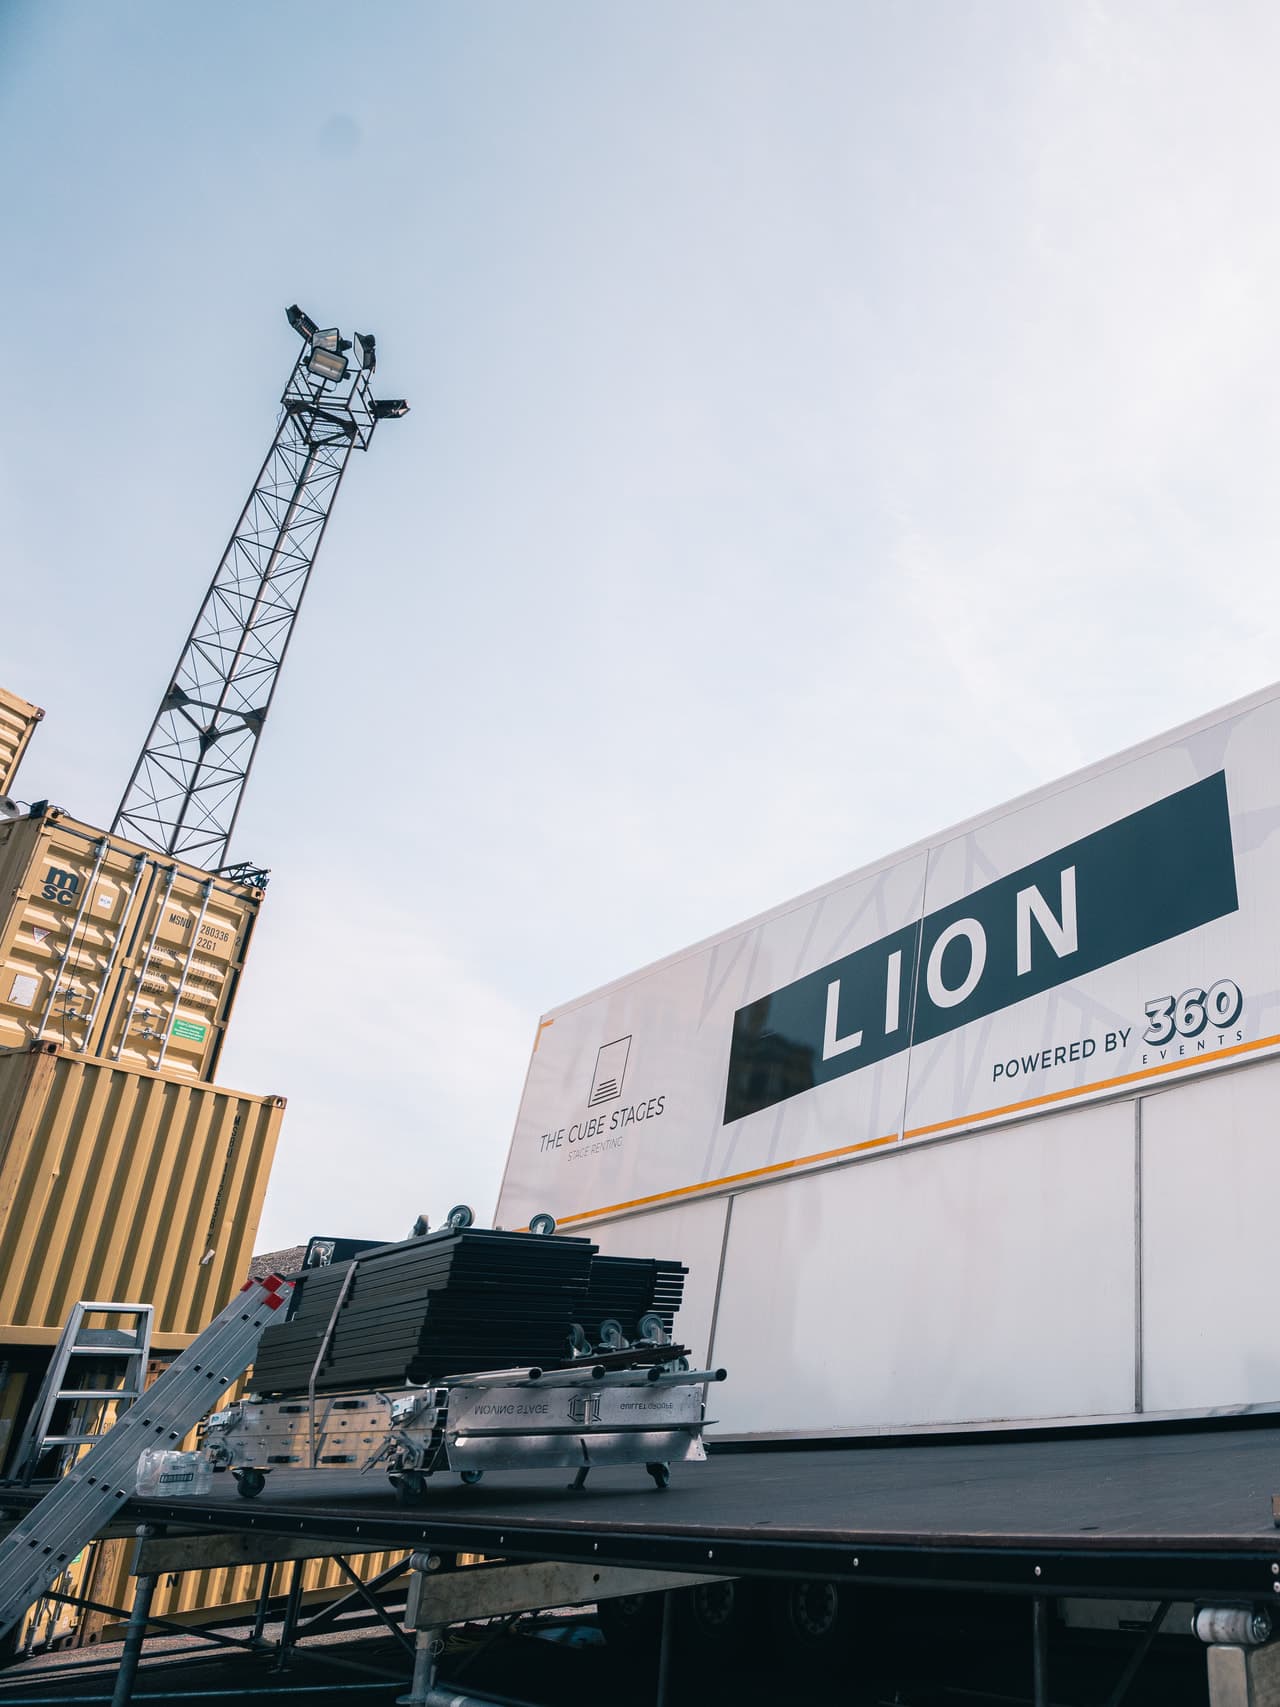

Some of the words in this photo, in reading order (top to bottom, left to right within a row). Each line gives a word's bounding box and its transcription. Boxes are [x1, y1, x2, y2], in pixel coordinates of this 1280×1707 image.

[168, 913, 192, 929] MSNU
[200, 925, 229, 942] 280336
[197, 937, 217, 951] 22G1
[823, 865, 1078, 1061] LION
[993, 1038, 1096, 1082] POWERED
[1104, 1027, 1132, 1052] BY
[1142, 979, 1243, 1046] 360
[1142, 1030, 1242, 1065] EVENTS
[540, 1128, 565, 1152] THE
[568, 1115, 606, 1143] CUBE
[609, 1096, 666, 1130] STAGES
